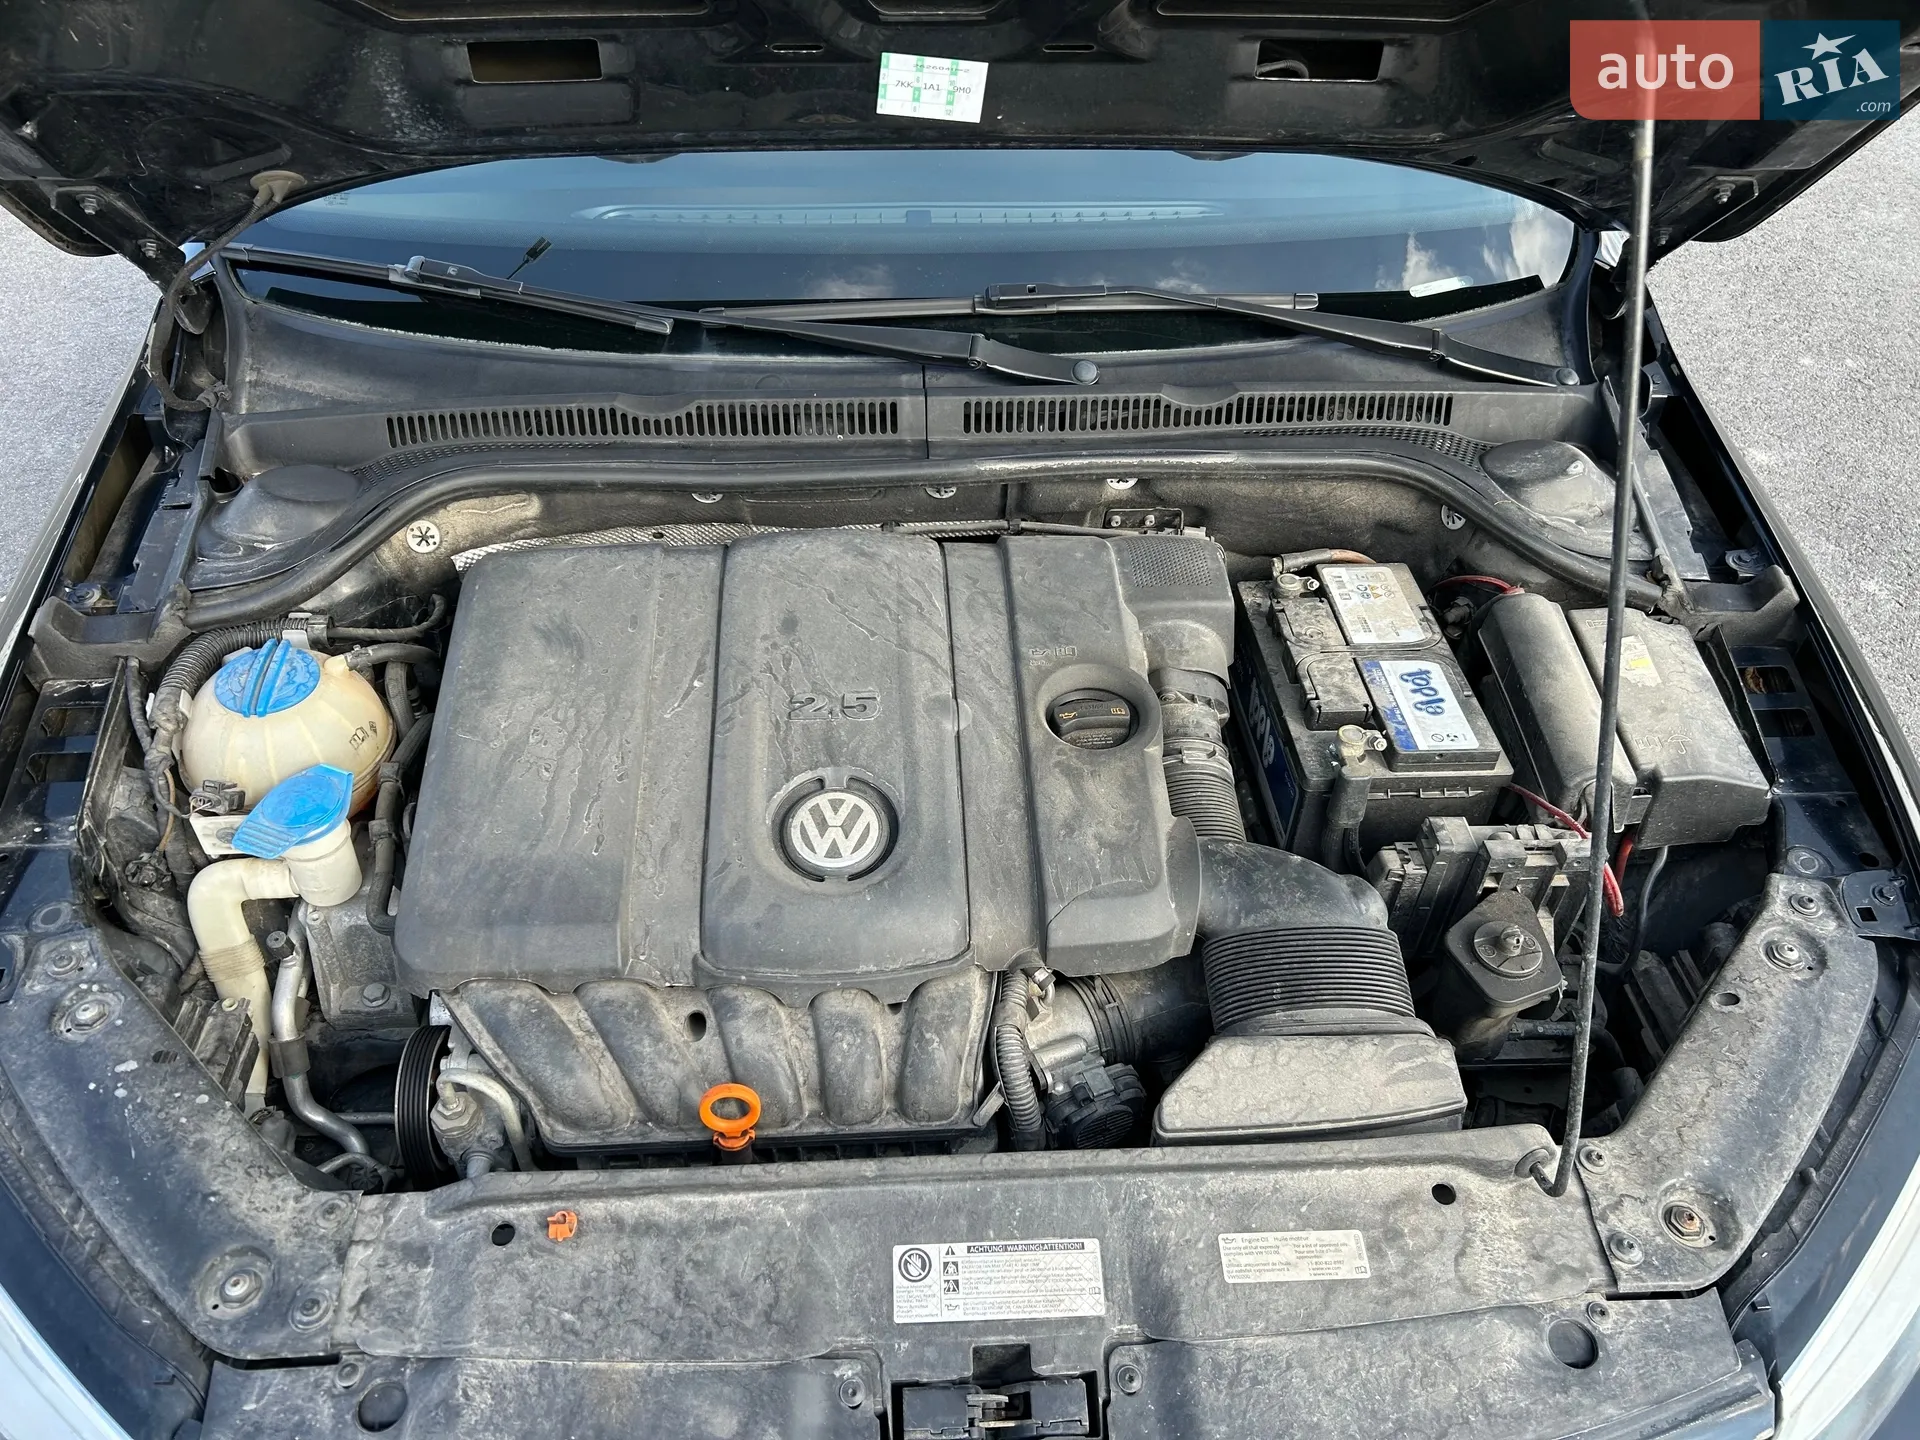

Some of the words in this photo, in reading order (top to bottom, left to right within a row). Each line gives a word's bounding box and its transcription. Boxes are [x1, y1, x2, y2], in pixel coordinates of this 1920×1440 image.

[895, 80, 914, 88] 7KK
[923, 83, 941, 91] 1A1
[789, 690, 881, 721] 2.5
[1400, 668, 1445, 715] topla
[796, 795, 874, 864] VW
[970, 1245, 1006, 1253] ACHTUNG!
[1007, 1244, 1043, 1252] WARNING!
